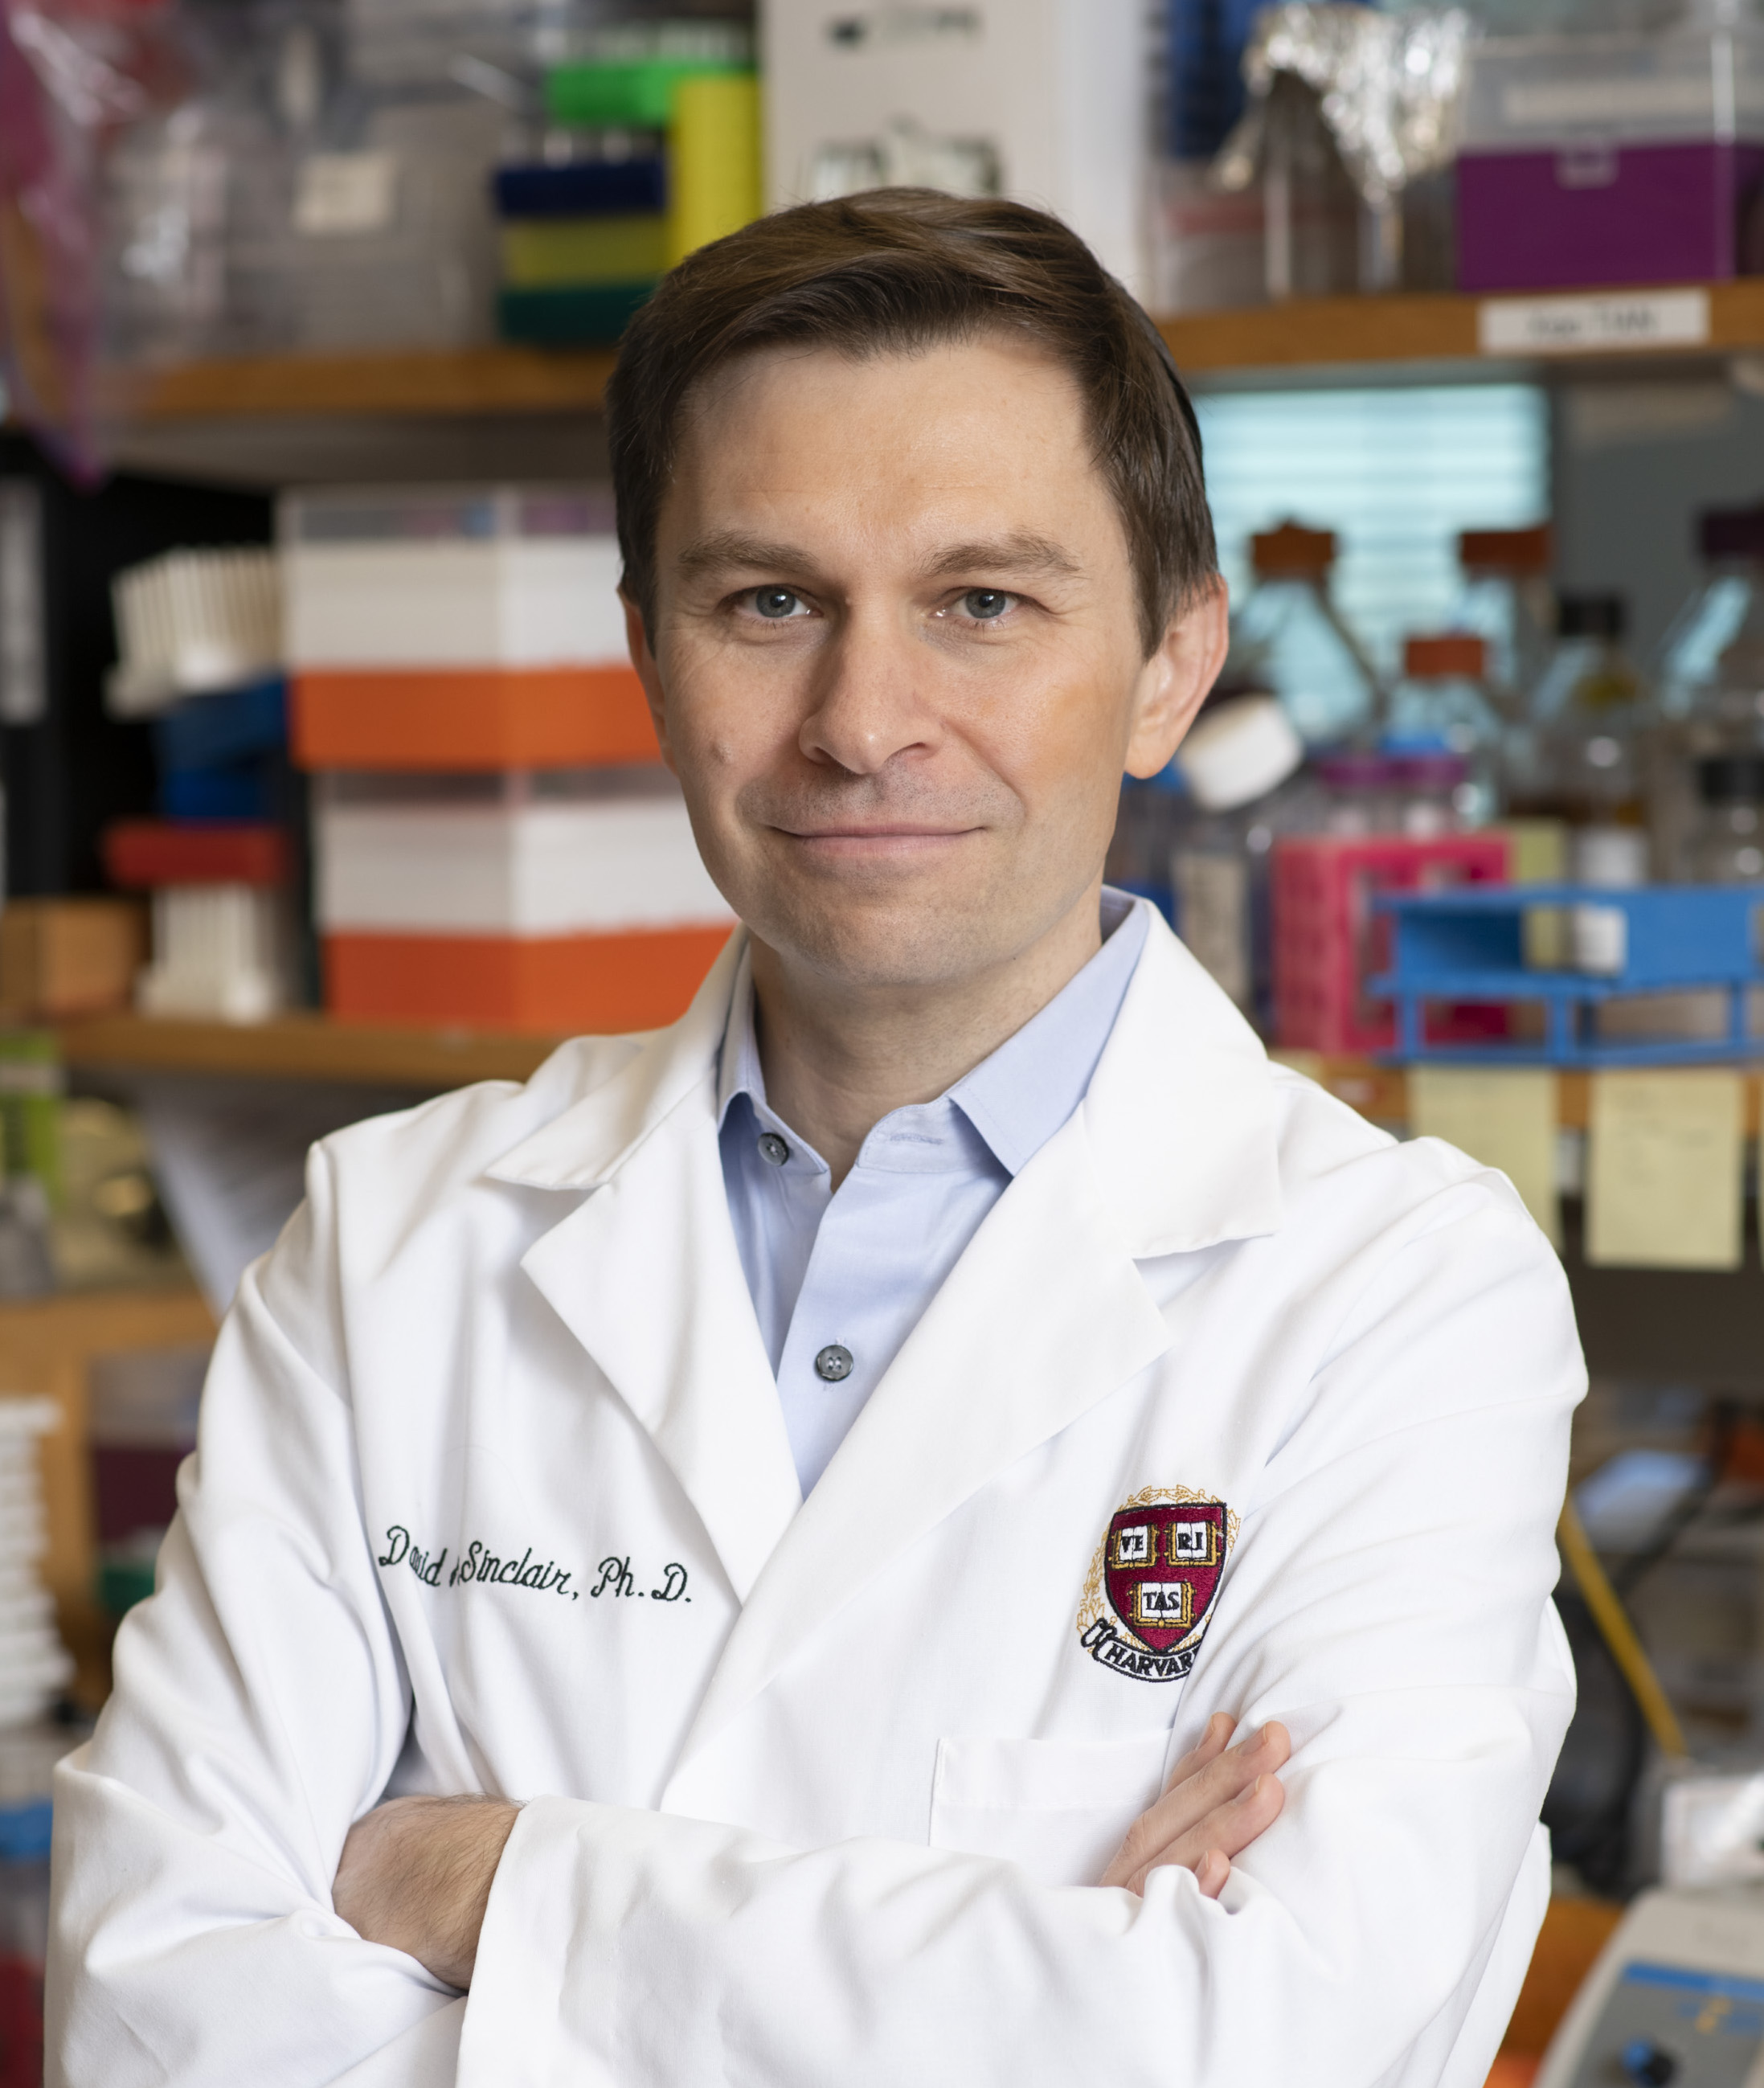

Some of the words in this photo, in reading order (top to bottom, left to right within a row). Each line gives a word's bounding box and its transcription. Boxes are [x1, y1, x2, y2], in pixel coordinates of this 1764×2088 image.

[1120, 1534, 1144, 1553] VE
[1177, 1531, 1204, 1550] RI
[378, 1525, 448, 1587] David
[460, 1540, 579, 1600] Sinclair,
[1143, 1591, 1180, 1611] TAS
[1104, 1642, 1201, 1677] HARVAR
